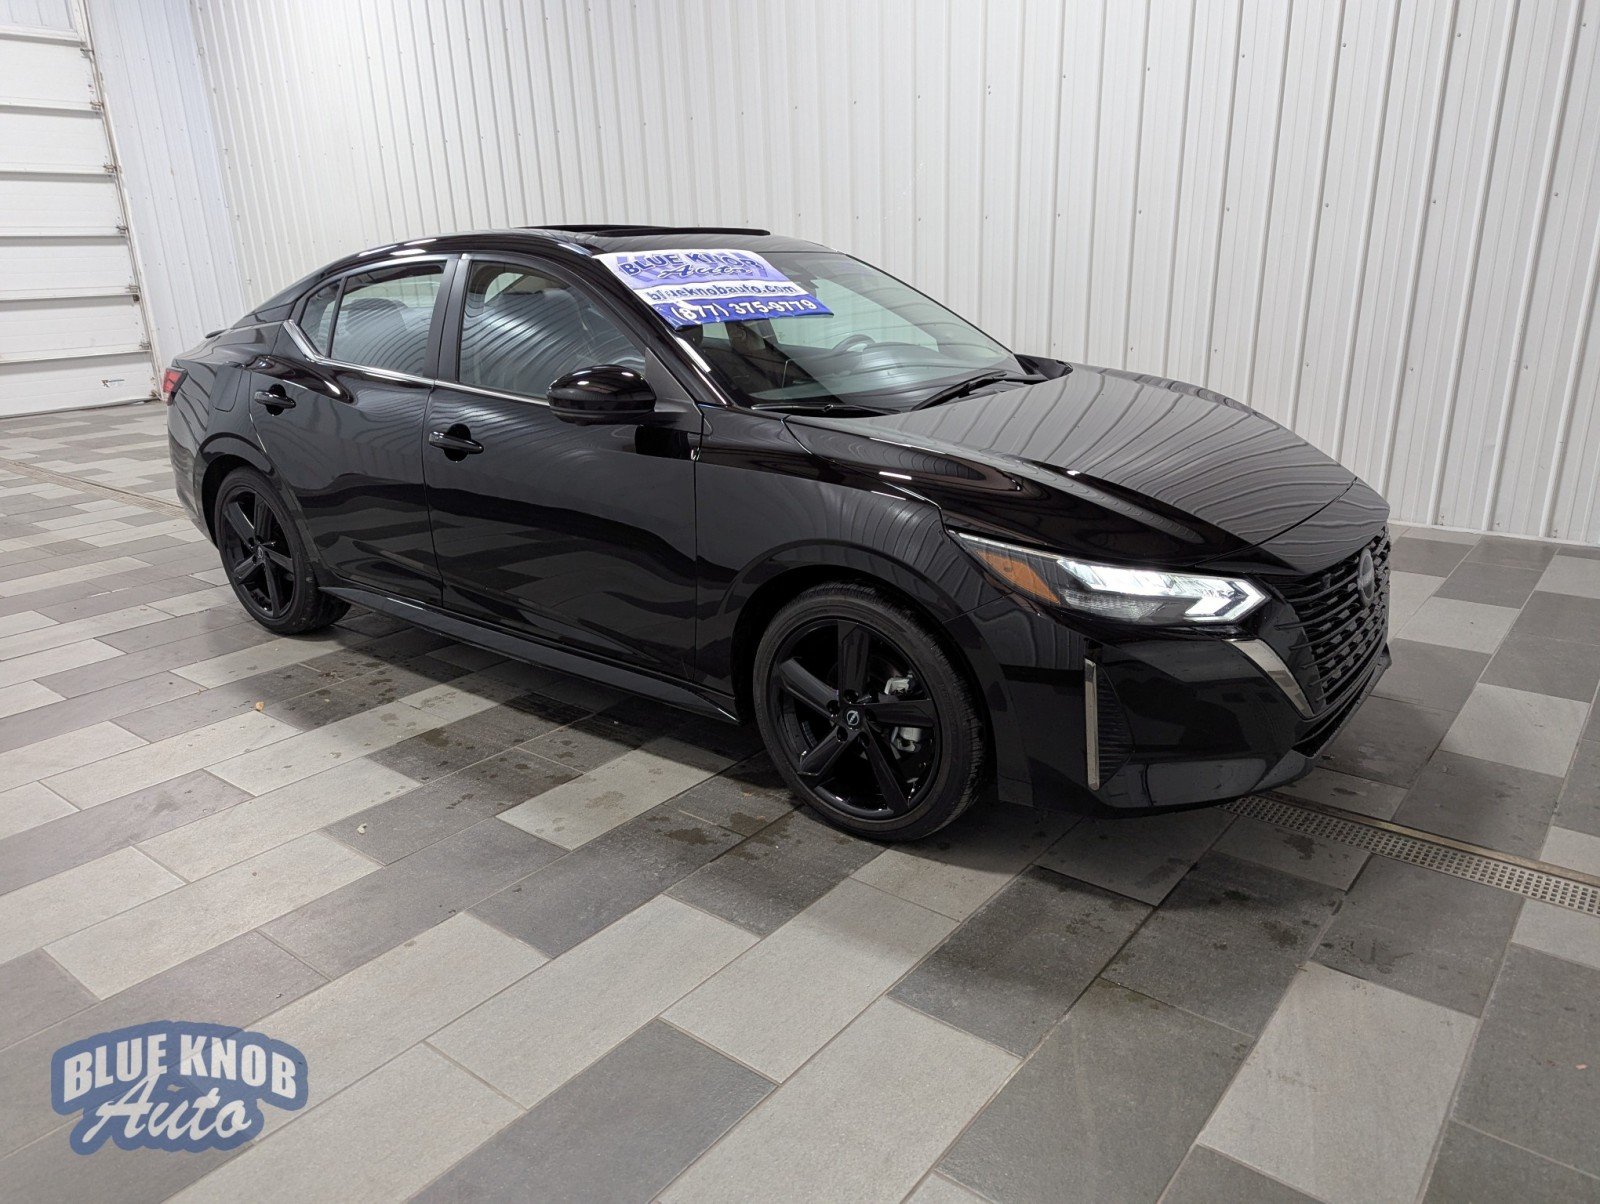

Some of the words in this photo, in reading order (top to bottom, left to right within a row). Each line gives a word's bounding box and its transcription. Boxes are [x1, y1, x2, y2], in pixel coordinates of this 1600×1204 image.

[619, 254, 683, 276] BLUE
[671, 303, 730, 321] (877)
[734, 300, 817, 315] 375-9779
